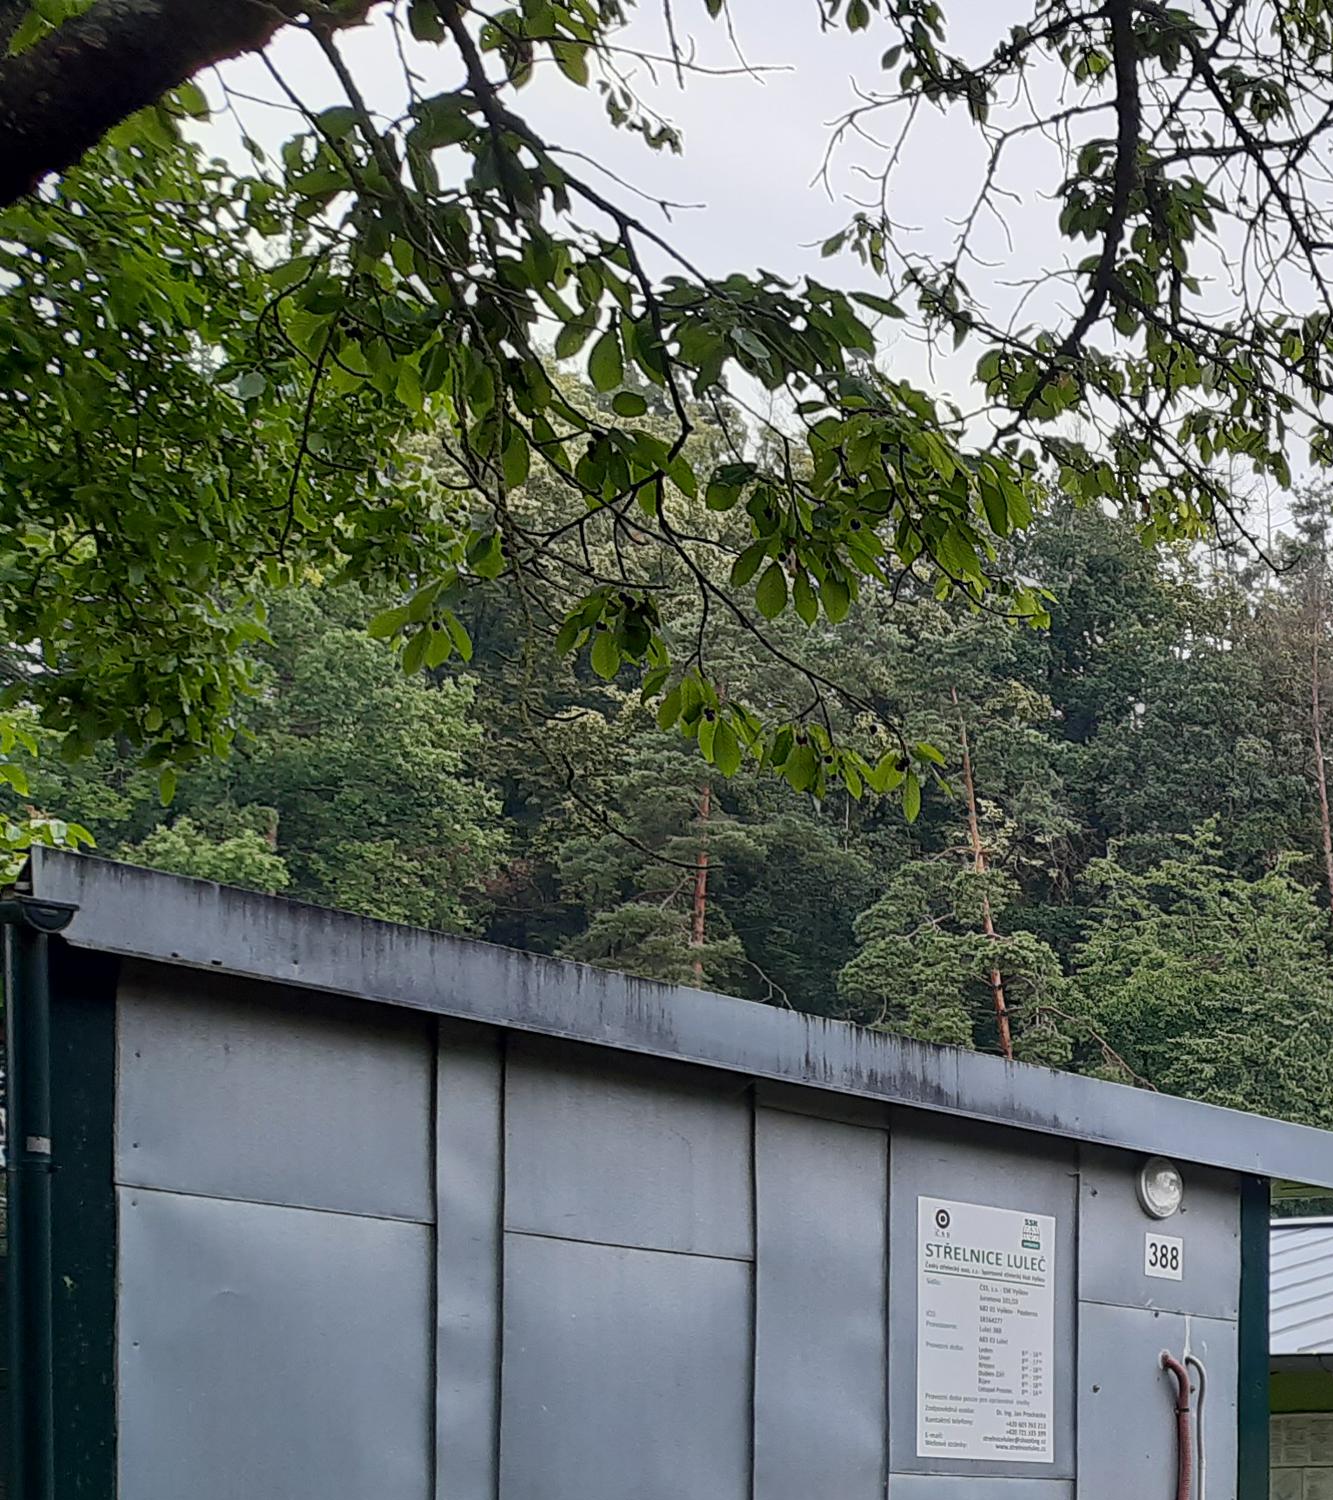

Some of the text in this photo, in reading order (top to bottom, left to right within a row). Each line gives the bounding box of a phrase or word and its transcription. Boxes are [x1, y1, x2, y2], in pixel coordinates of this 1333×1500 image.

[925, 1242, 1046, 1273] STŘELNICE LULEČ
[1149, 1242, 1179, 1271] 388
